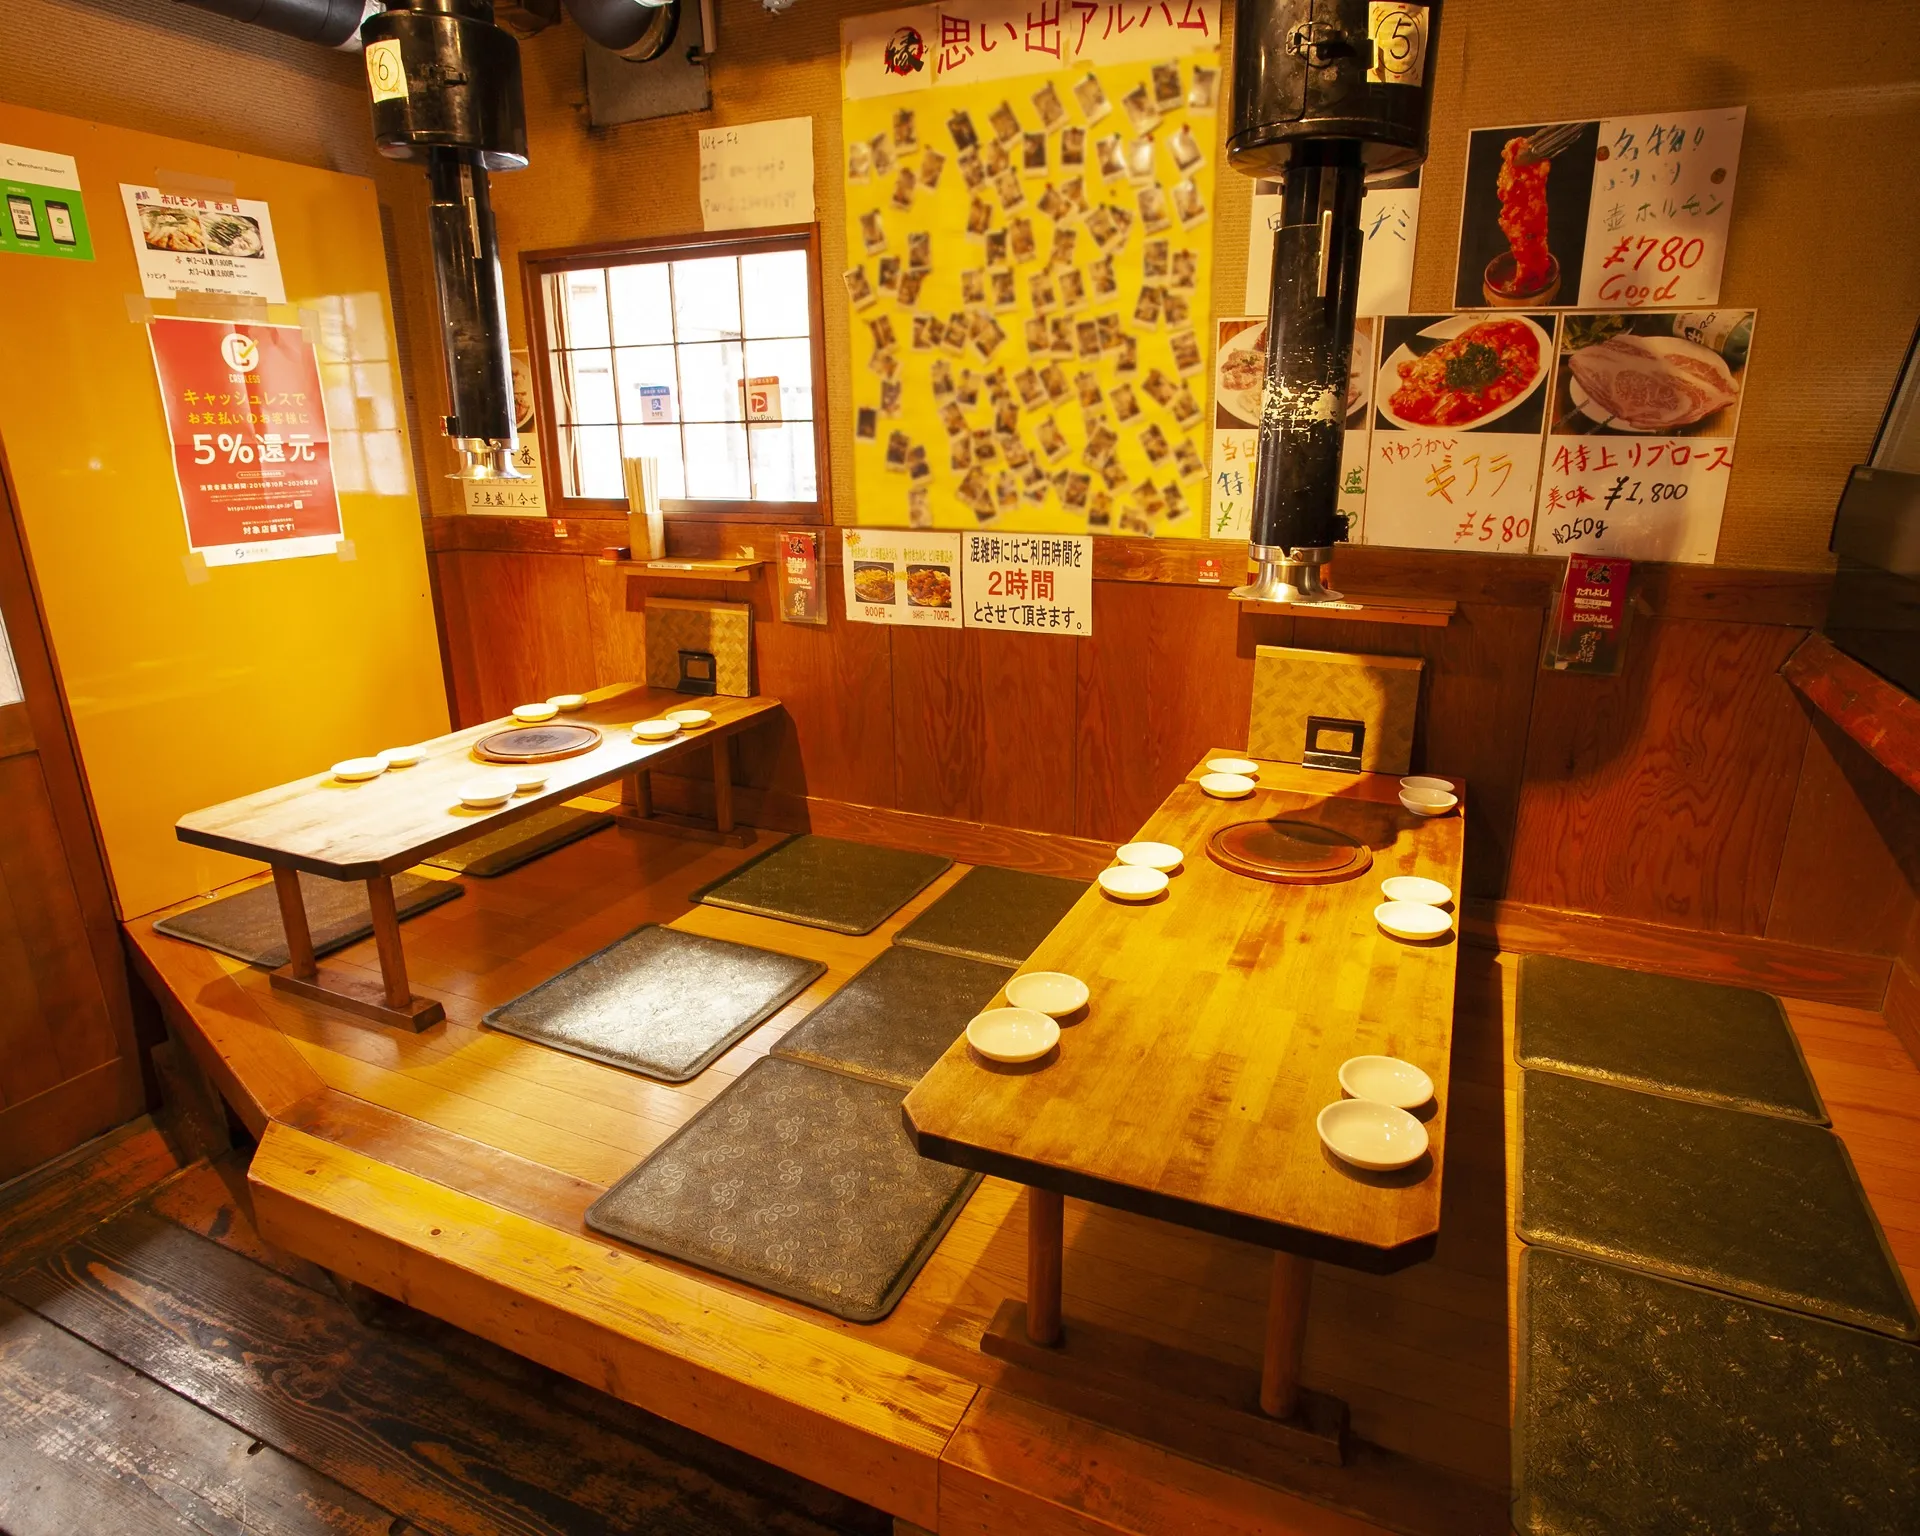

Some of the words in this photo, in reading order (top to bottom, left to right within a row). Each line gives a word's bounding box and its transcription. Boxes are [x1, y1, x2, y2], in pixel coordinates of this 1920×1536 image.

[1598, 274, 1681, 303] Good
[183, 389, 307, 406] キャッシュレスで
[188, 411, 310, 425] お支払いのお客様に
[192, 433, 316, 465] 5%還元
[1552, 440, 1733, 476] 特上リブロース
[1424, 453, 1513, 505] ギアラ
[1603, 475, 1689, 511] ¥1,800
[1545, 485, 1596, 516] 美味
[1453, 510, 1531, 544] ¥580
[970, 536, 1083, 568] 混雑時にはご利用時間を
[988, 567, 1055, 602] 2時間
[973, 601, 1083, 630] とさせて頂きます。
